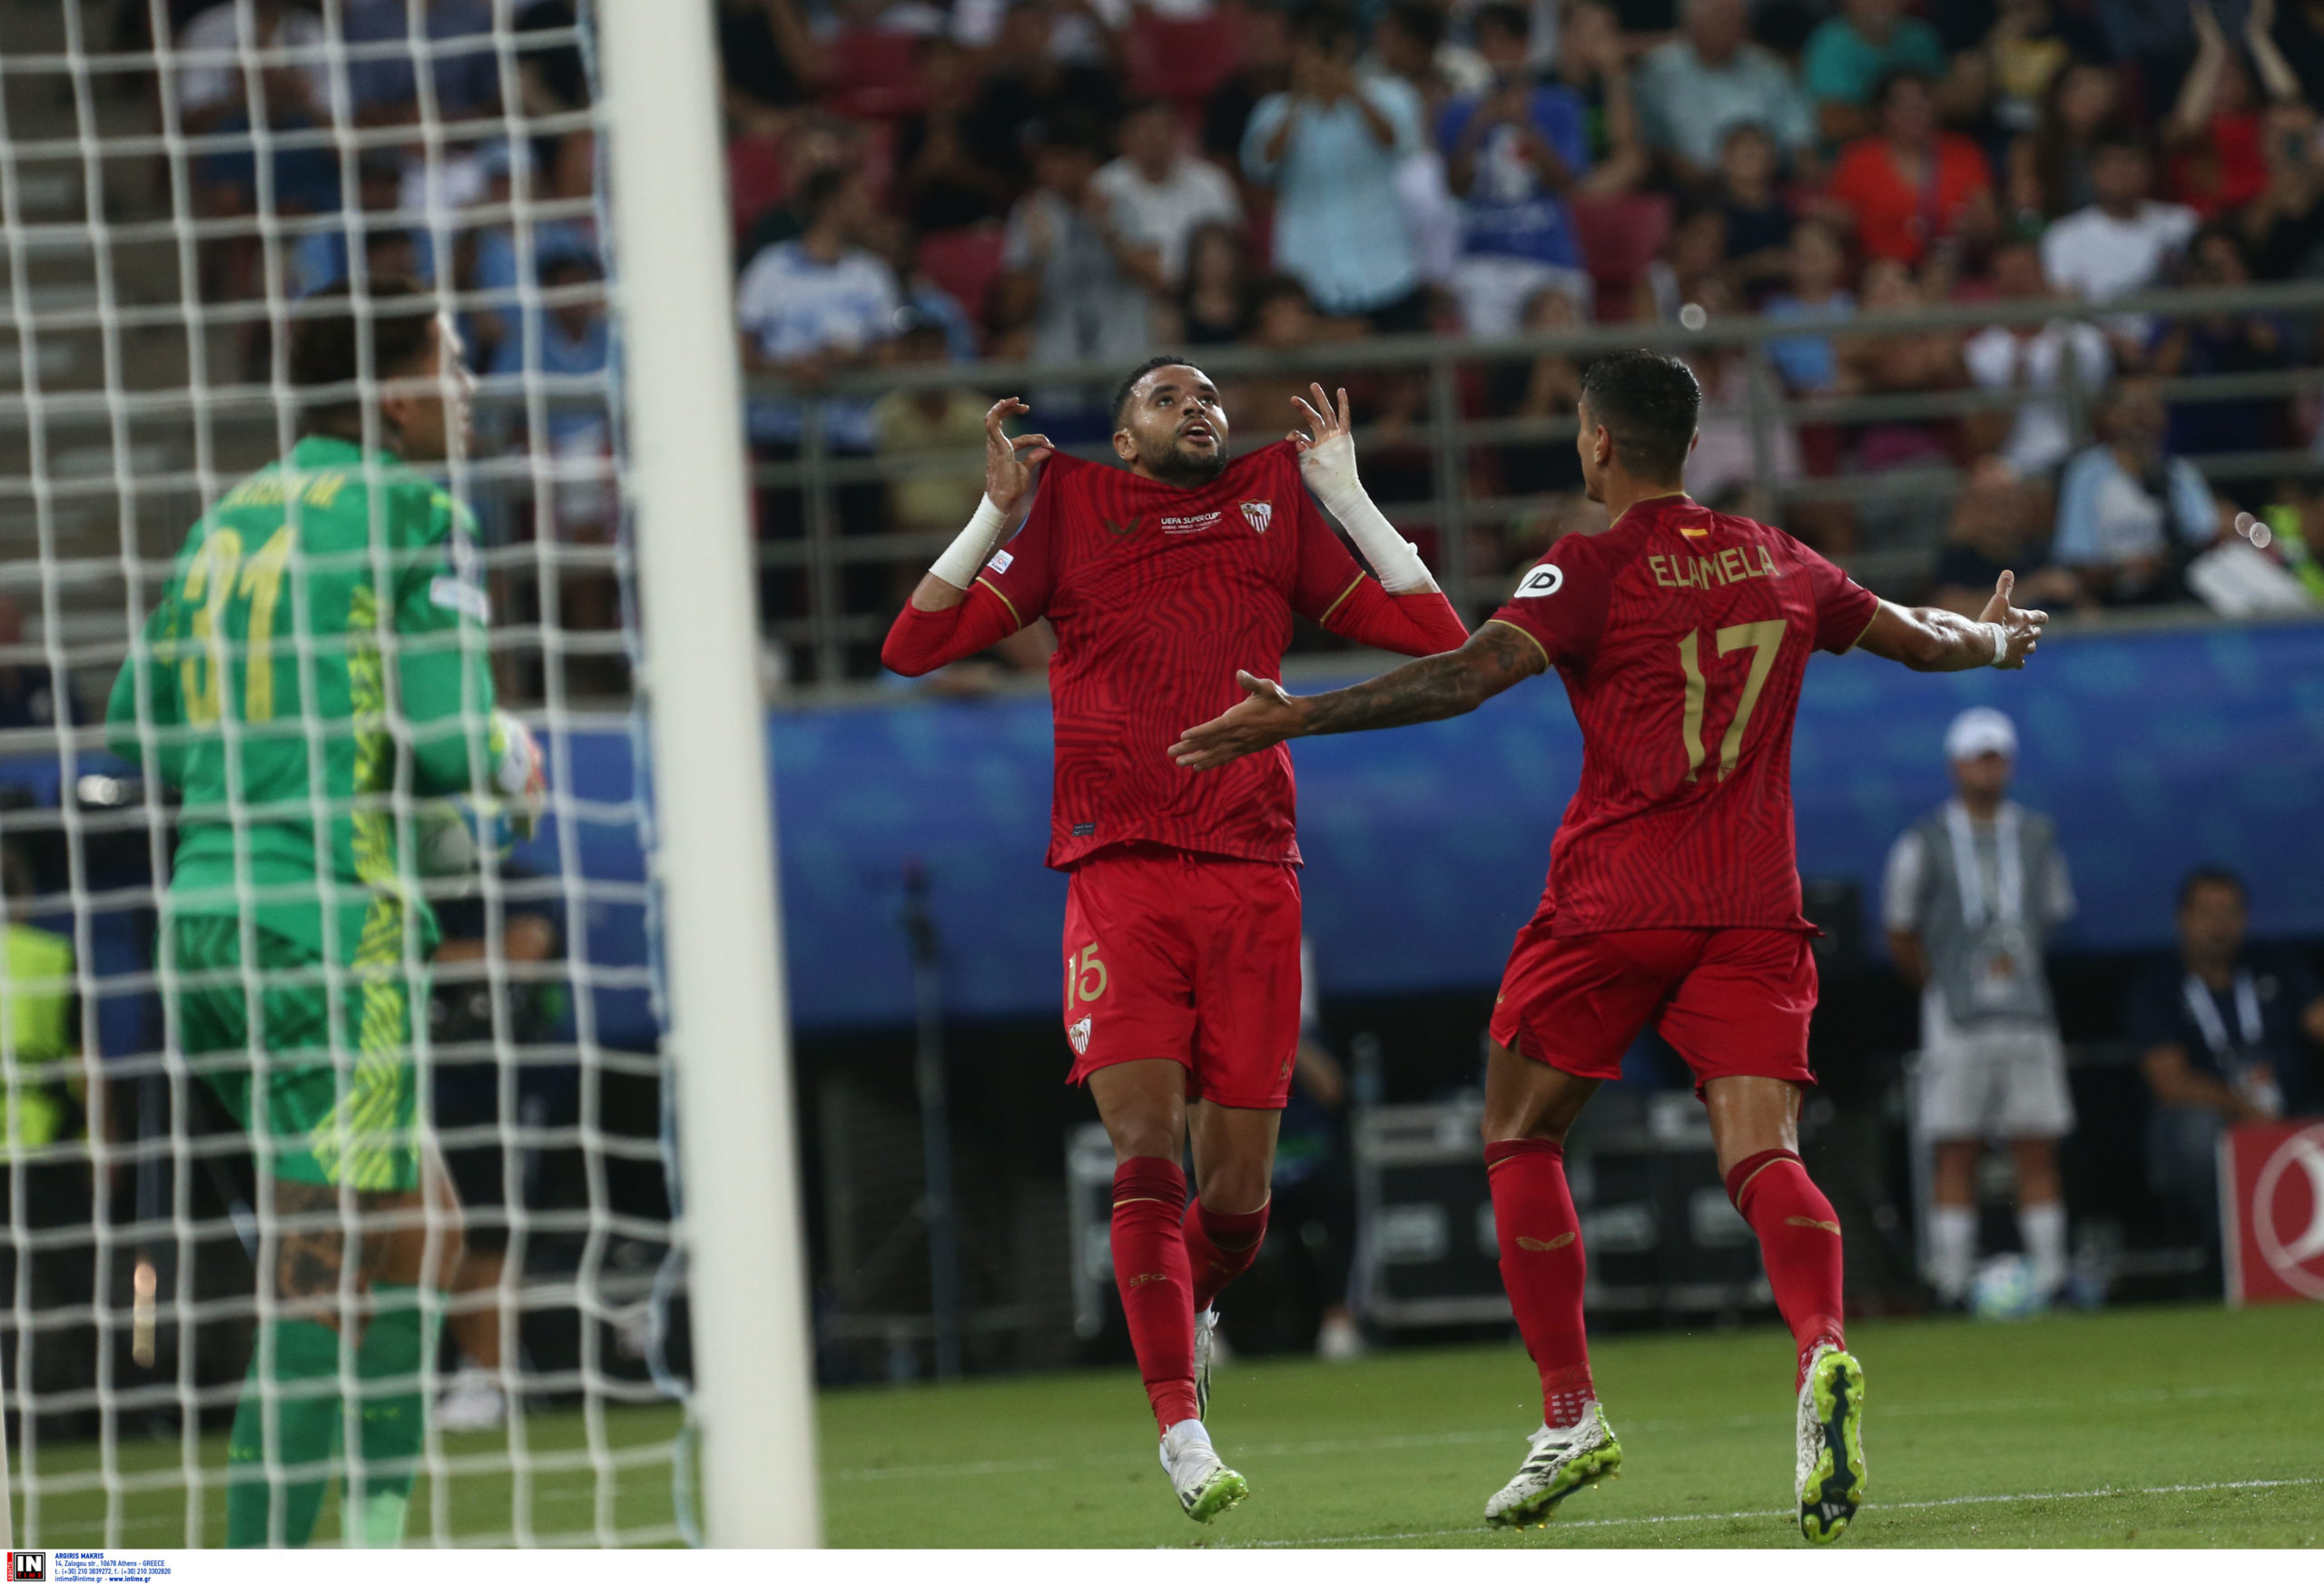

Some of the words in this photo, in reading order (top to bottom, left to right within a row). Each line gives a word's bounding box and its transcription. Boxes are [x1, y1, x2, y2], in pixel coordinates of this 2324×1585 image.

[1183, 514, 1204, 524] SUPER
[182, 525, 297, 731] 31
[1678, 618, 1787, 783] 17
[1068, 941, 1108, 1011] 15
